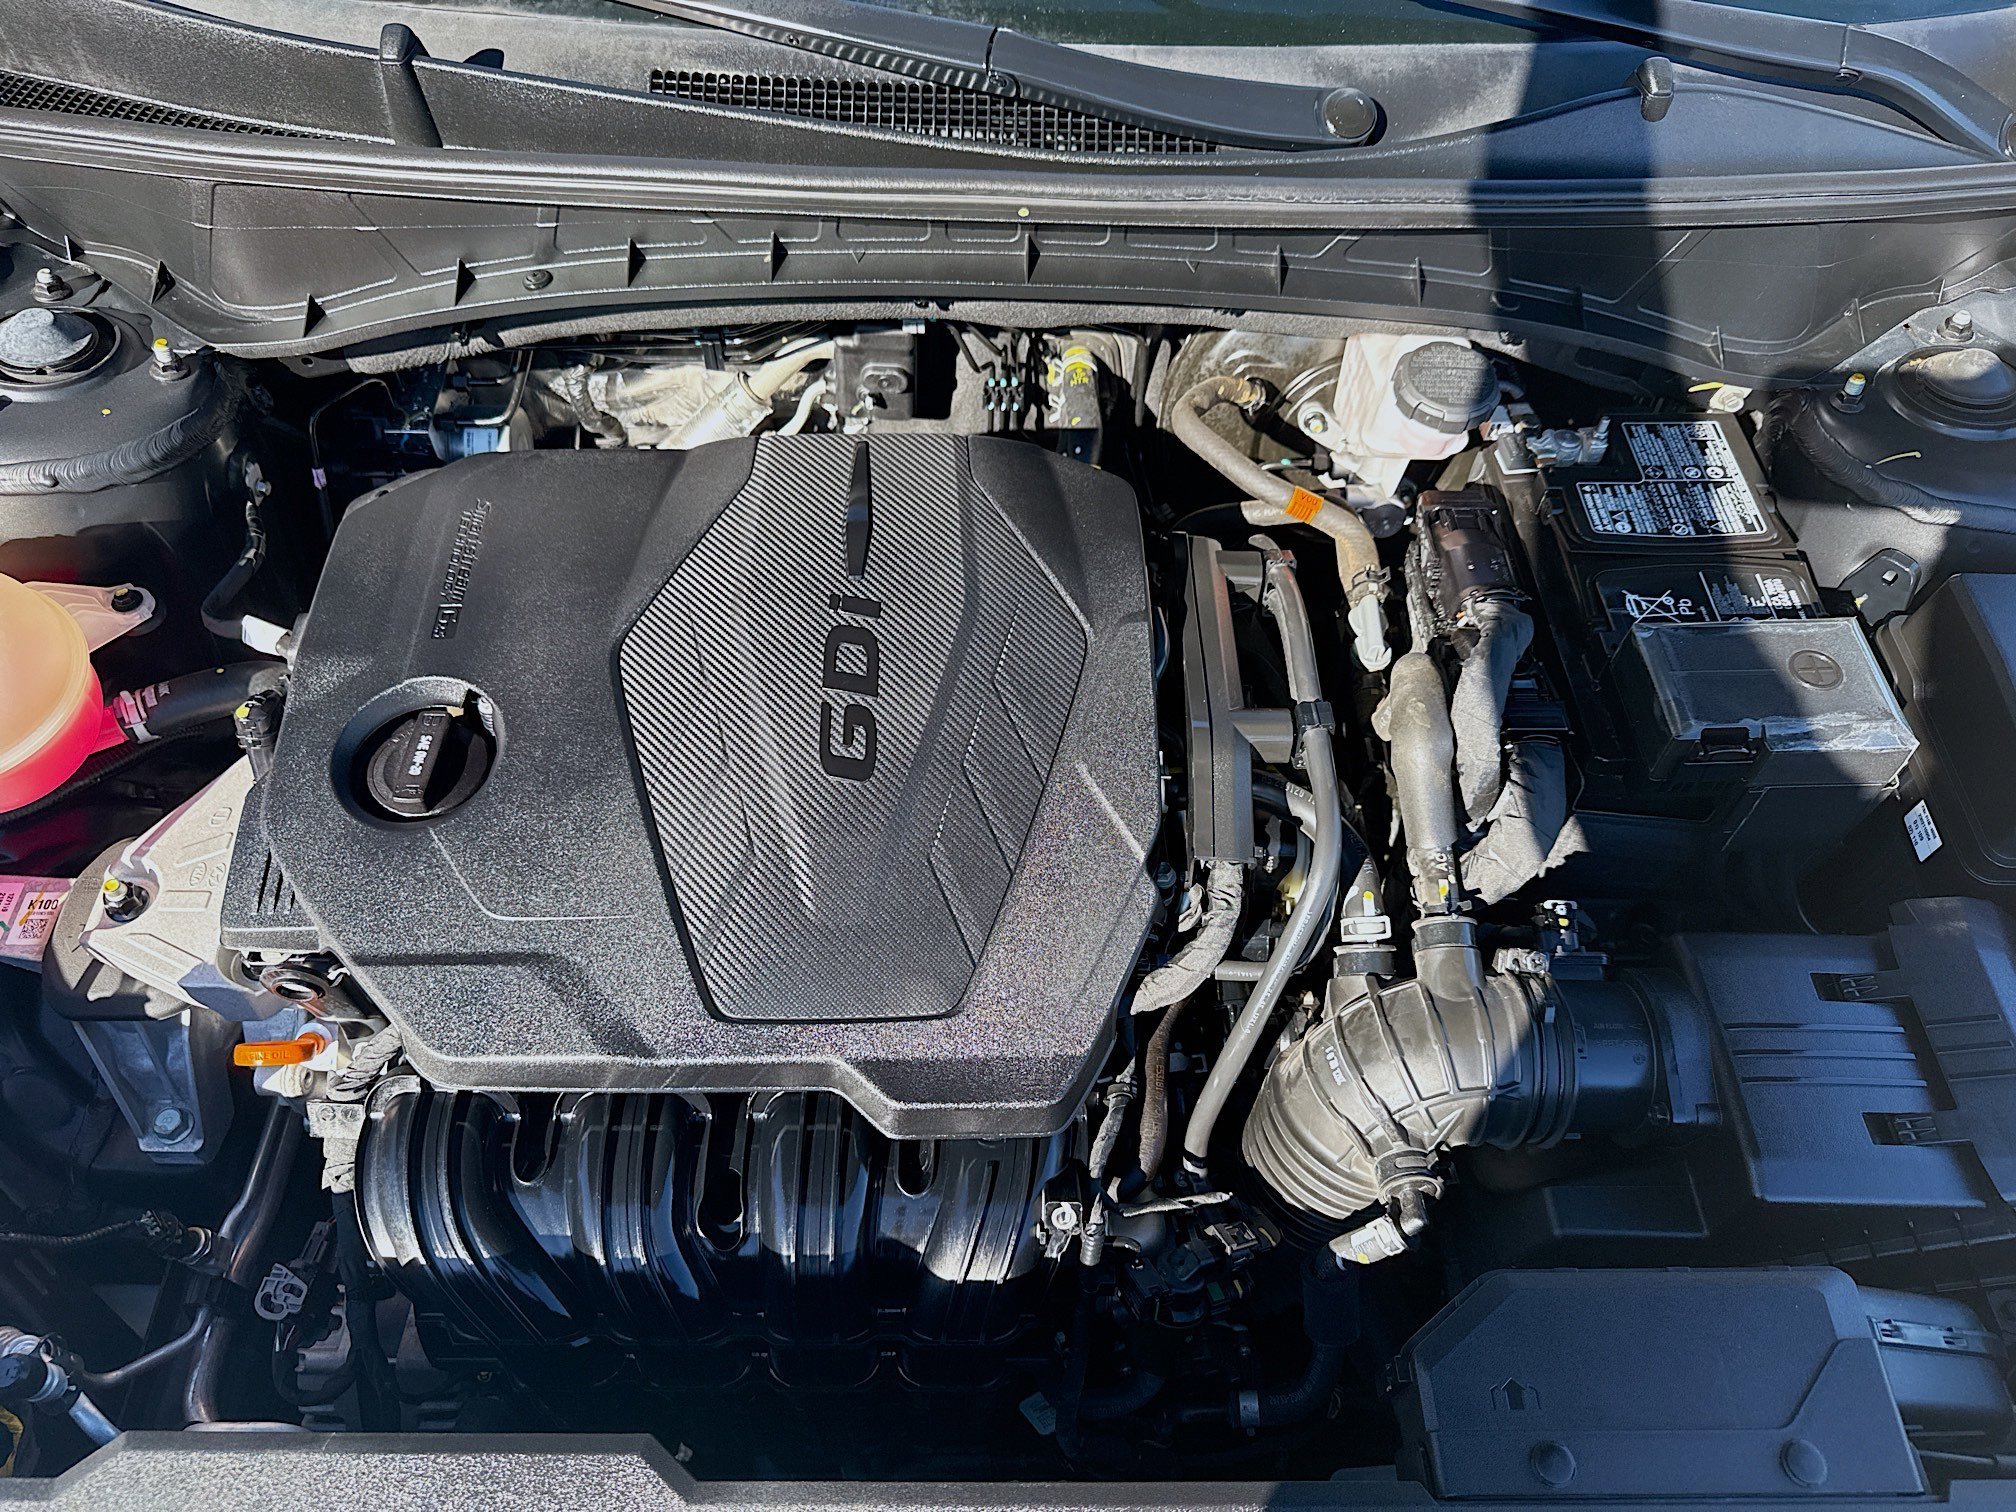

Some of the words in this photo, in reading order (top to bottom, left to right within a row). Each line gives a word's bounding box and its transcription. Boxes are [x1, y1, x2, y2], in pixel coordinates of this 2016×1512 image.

[440, 511, 471, 601] TECHNOLOGY
[452, 498, 491, 601] Smartstream
[1677, 598, 1696, 616] Pb
[819, 593, 881, 782] GDi
[416, 735, 433, 751] SAE
[27, 899, 59, 910] K100
